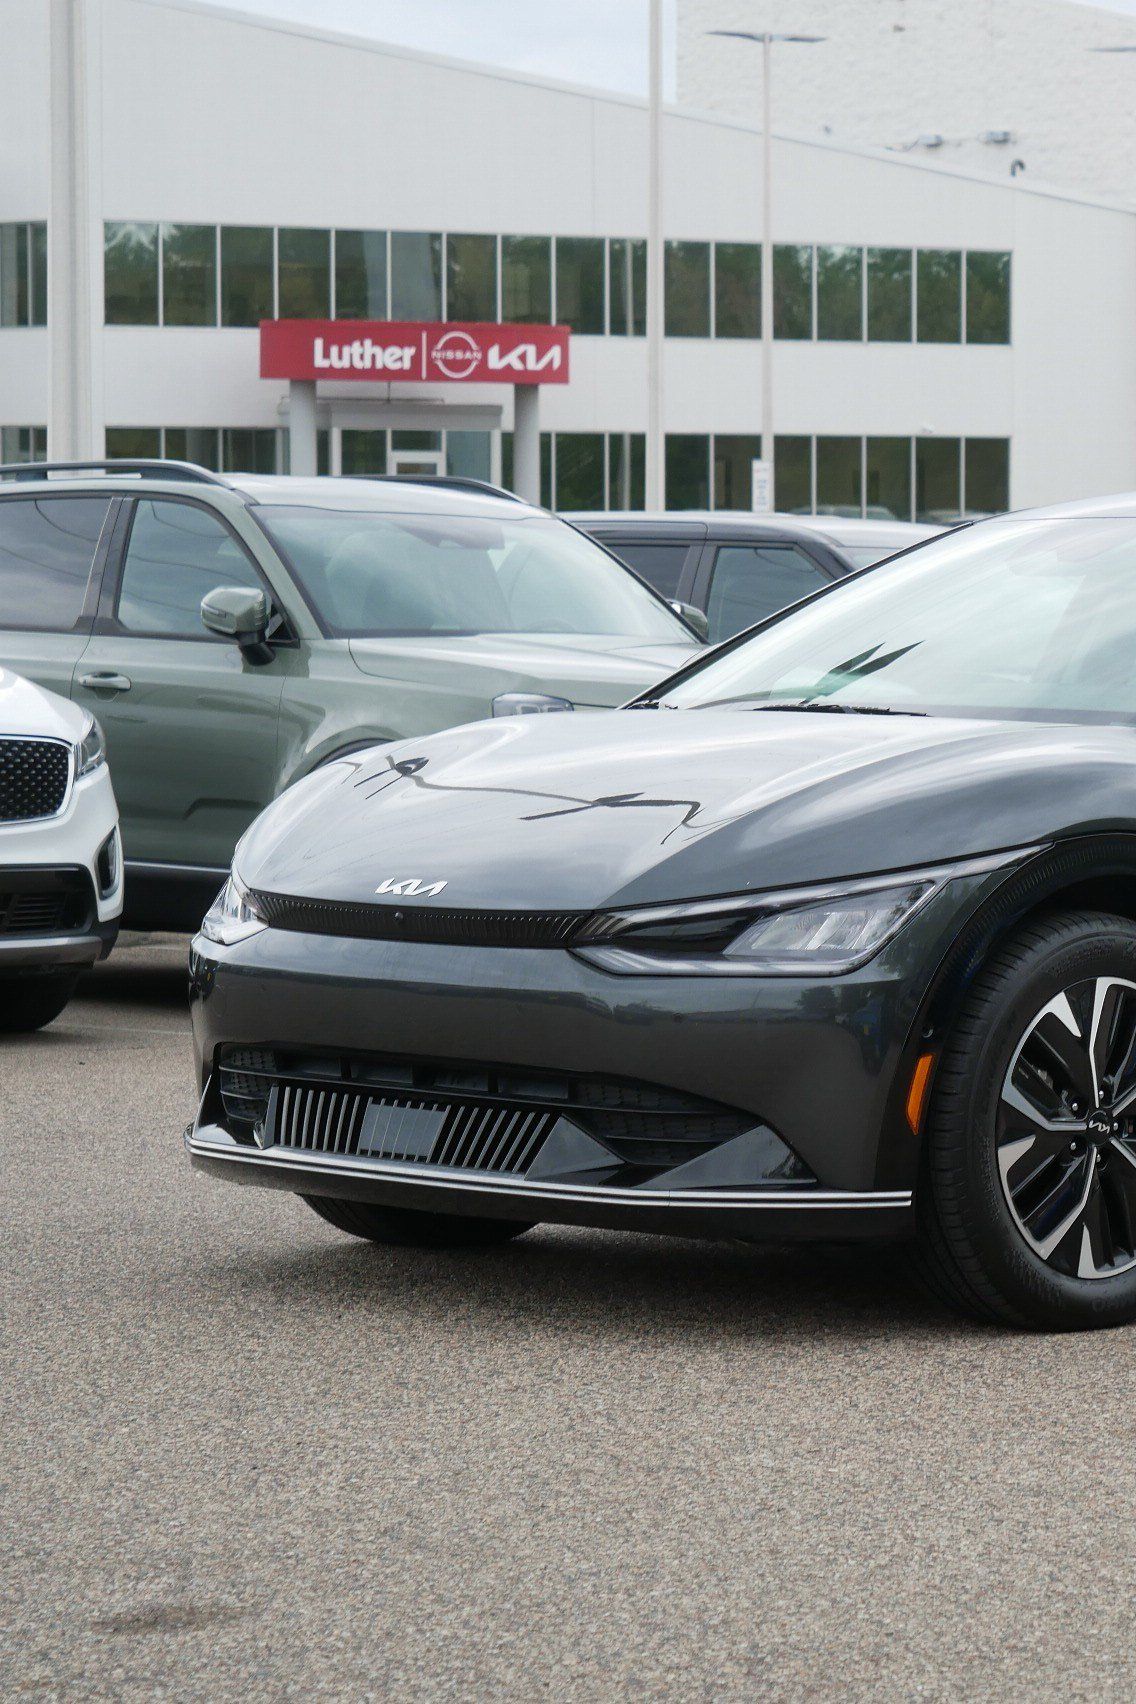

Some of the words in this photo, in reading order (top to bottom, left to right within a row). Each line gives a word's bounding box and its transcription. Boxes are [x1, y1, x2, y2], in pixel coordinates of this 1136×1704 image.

[313, 337, 416, 370] Luther
[431, 350, 482, 360] NISSAN
[488, 343, 562, 371] KIA
[374, 877, 448, 898] KIA
